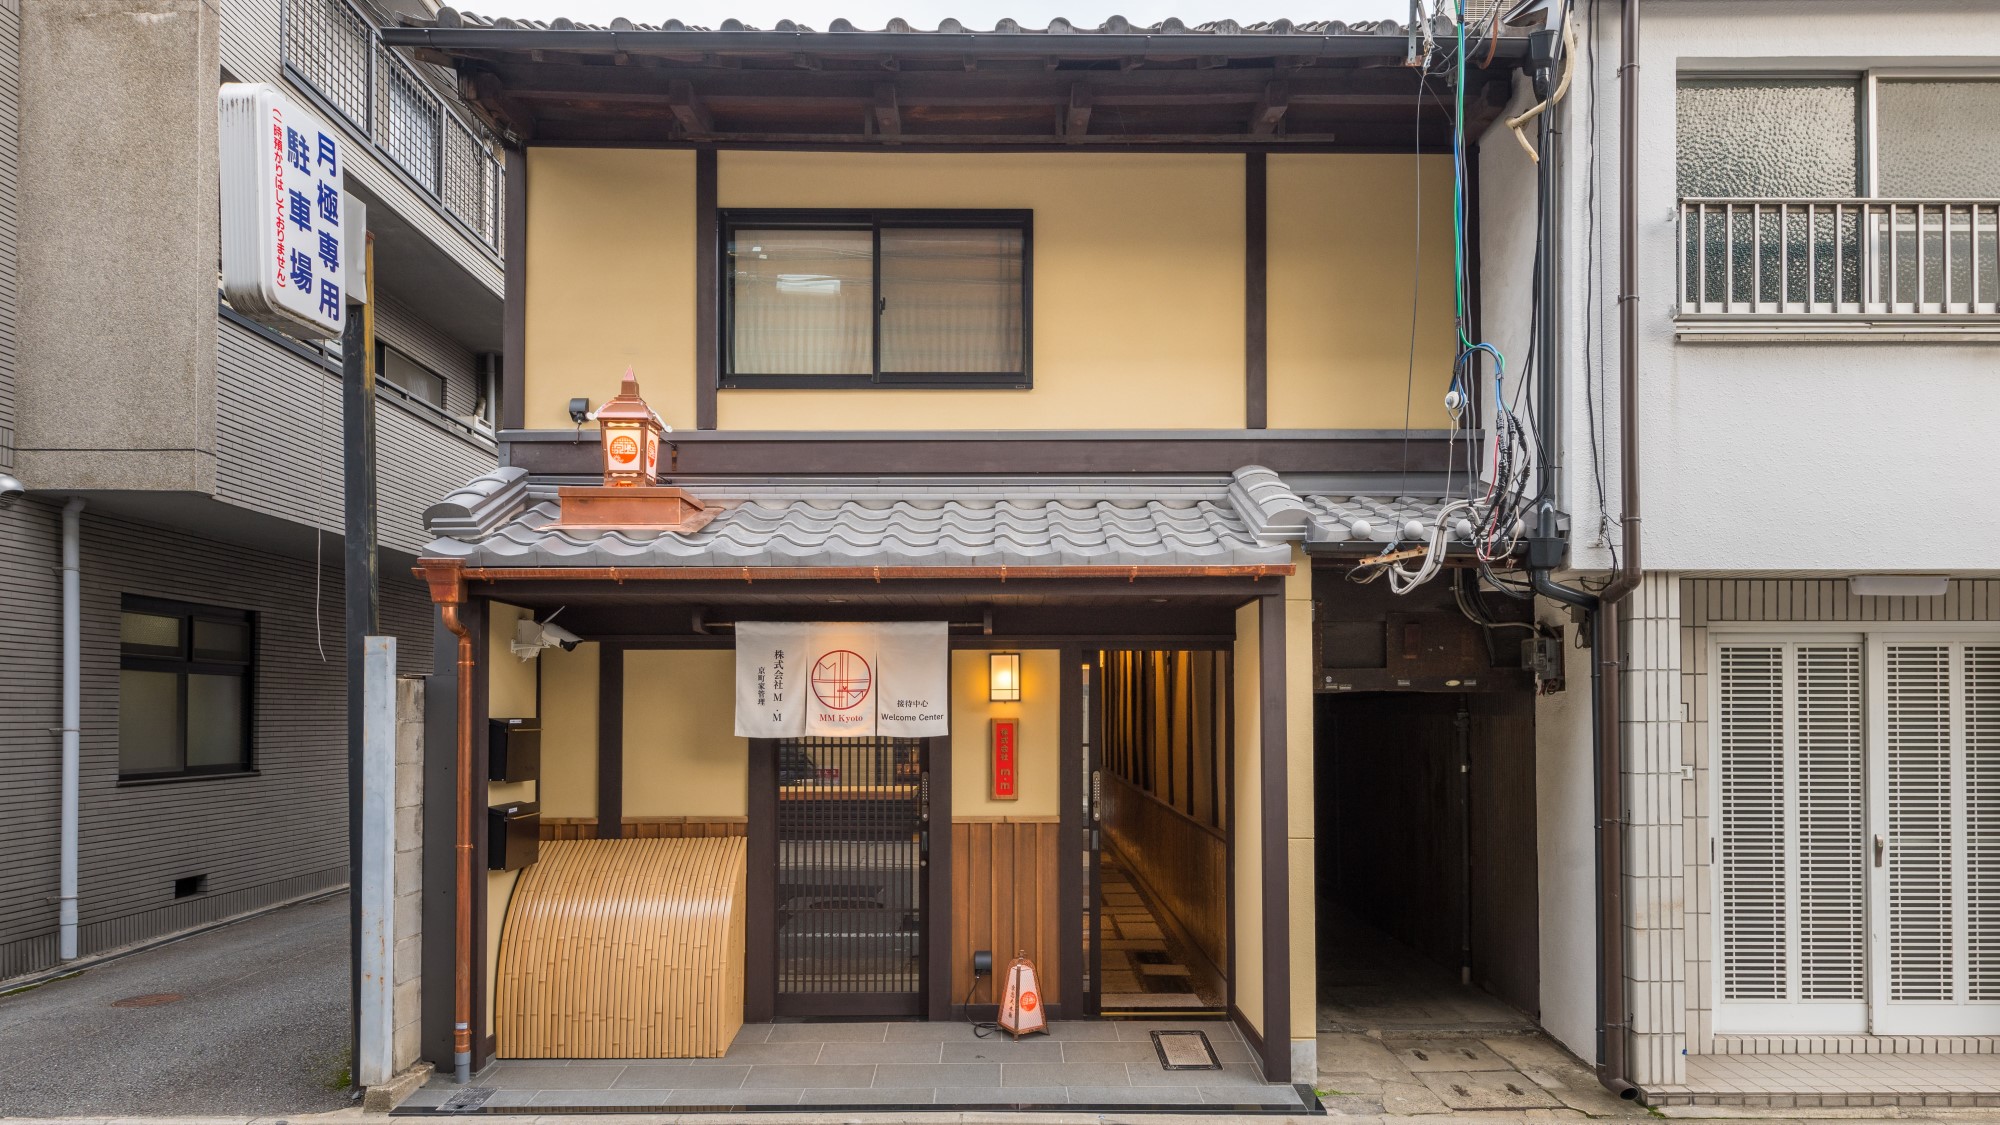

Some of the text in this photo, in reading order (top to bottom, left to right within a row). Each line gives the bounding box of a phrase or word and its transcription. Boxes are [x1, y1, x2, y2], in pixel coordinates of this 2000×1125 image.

[286, 125, 313, 295] 駐車場
[316, 130, 340, 322] 月極専用
[896, 699, 929, 708] 接待中心
[819, 713, 864, 724] MM Kyoto
[881, 713, 945, 722] Welcome Center
